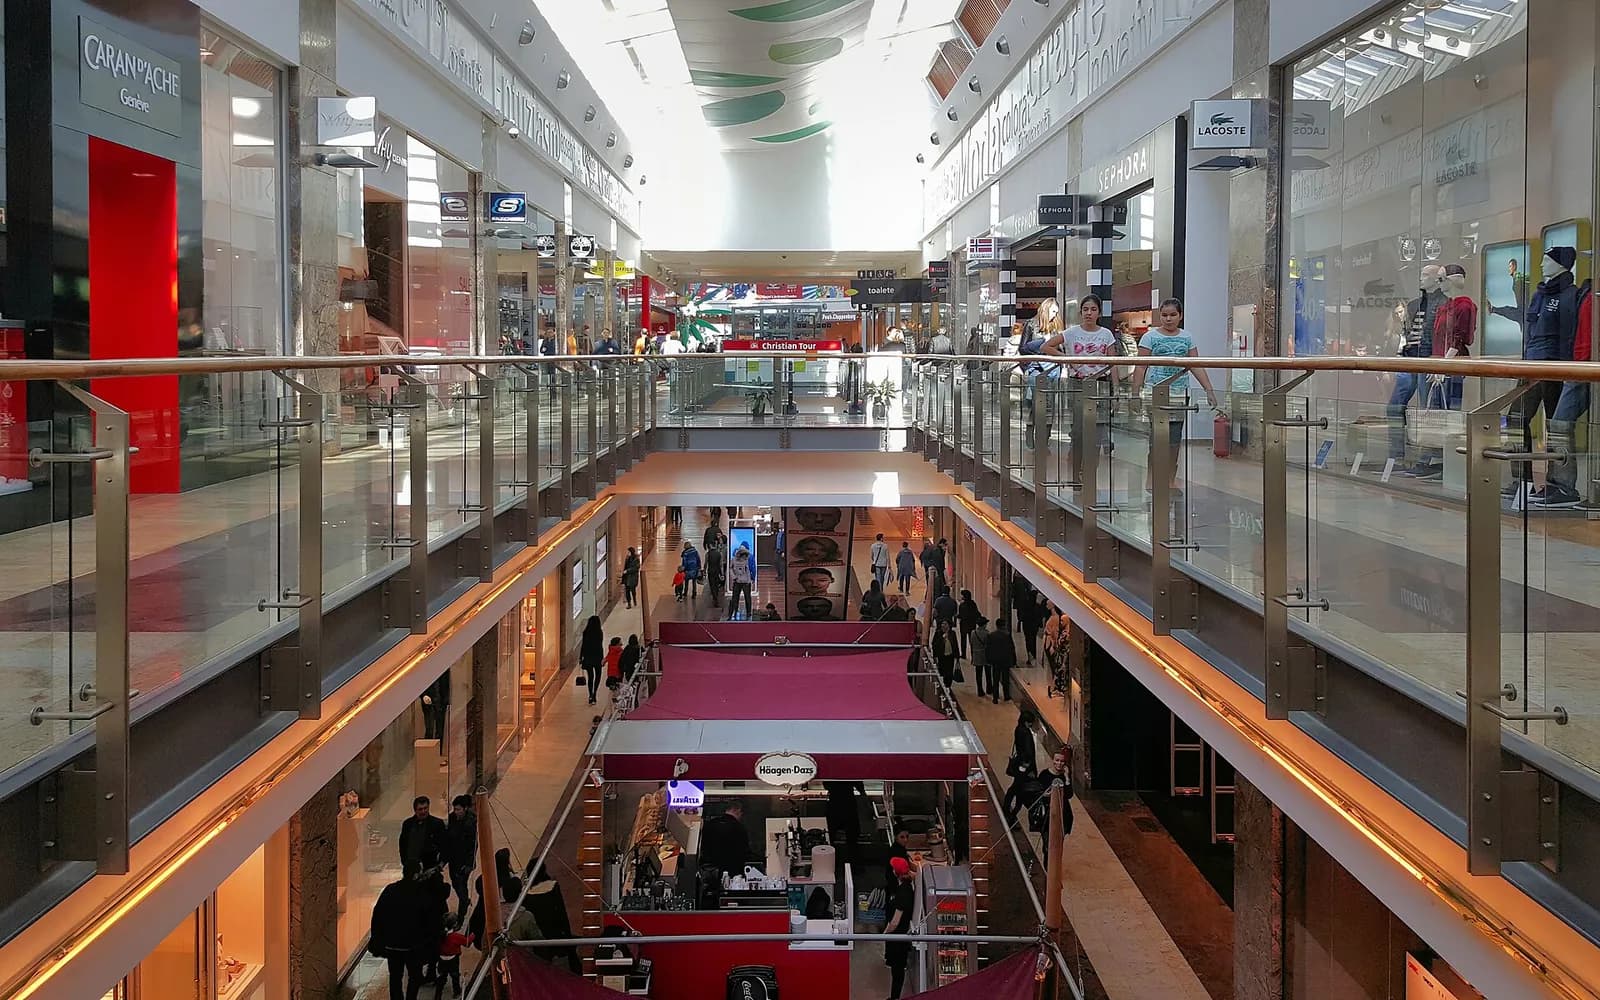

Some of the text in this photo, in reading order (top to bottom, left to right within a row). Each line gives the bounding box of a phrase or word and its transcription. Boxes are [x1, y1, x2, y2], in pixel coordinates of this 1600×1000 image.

[84, 34, 136, 80] CARAN
[120, 87, 150, 113] Genève
[1198, 126, 1246, 136] LACOSTE
[1098, 147, 1147, 193] SEPHORA
[1039, 206, 1072, 215] SEPHORA
[867, 286, 896, 295] toalete
[761, 342, 797, 350] Christian
[798, 342, 817, 350] Tour
